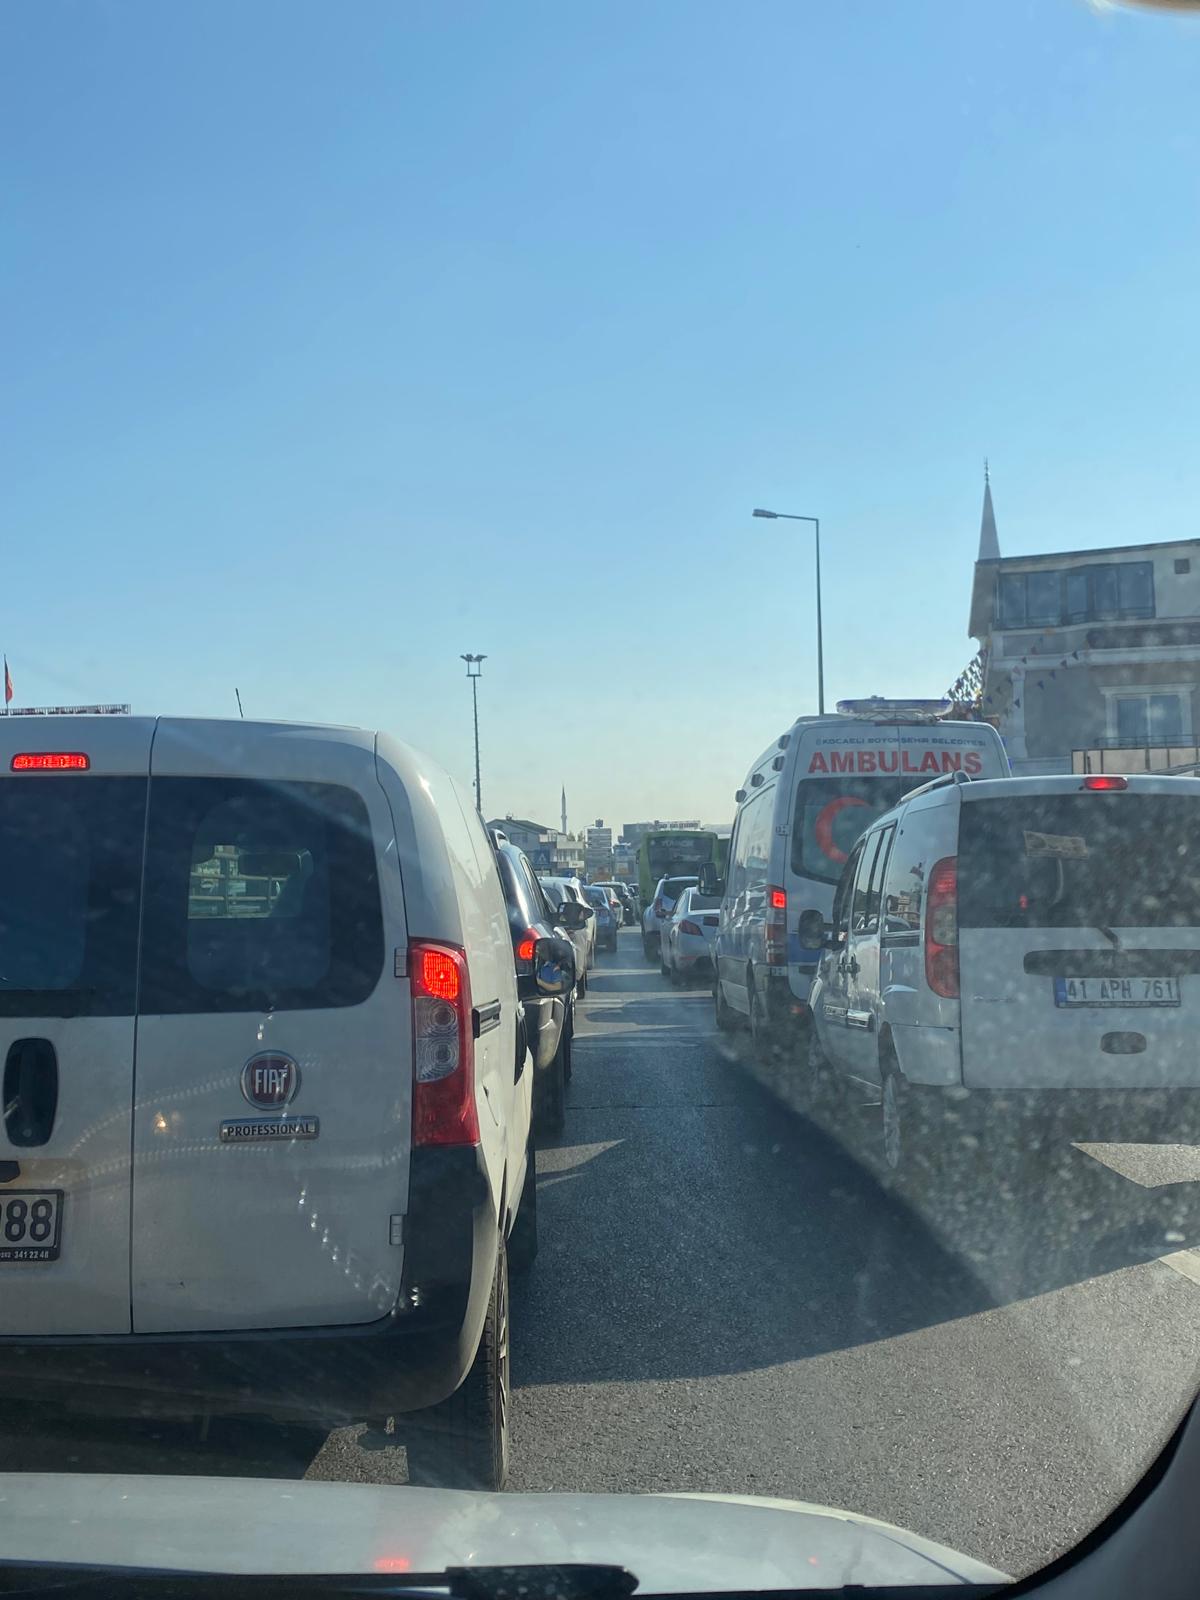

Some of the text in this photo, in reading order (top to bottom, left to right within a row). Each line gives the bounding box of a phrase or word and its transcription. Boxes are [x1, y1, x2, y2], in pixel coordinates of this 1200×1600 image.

[808, 751, 983, 774] AMBULANS
[1068, 980, 1173, 999] 41 APH 761
[255, 1068, 288, 1094] FIAT
[227, 1123, 313, 1137] PROFESSIONAL
